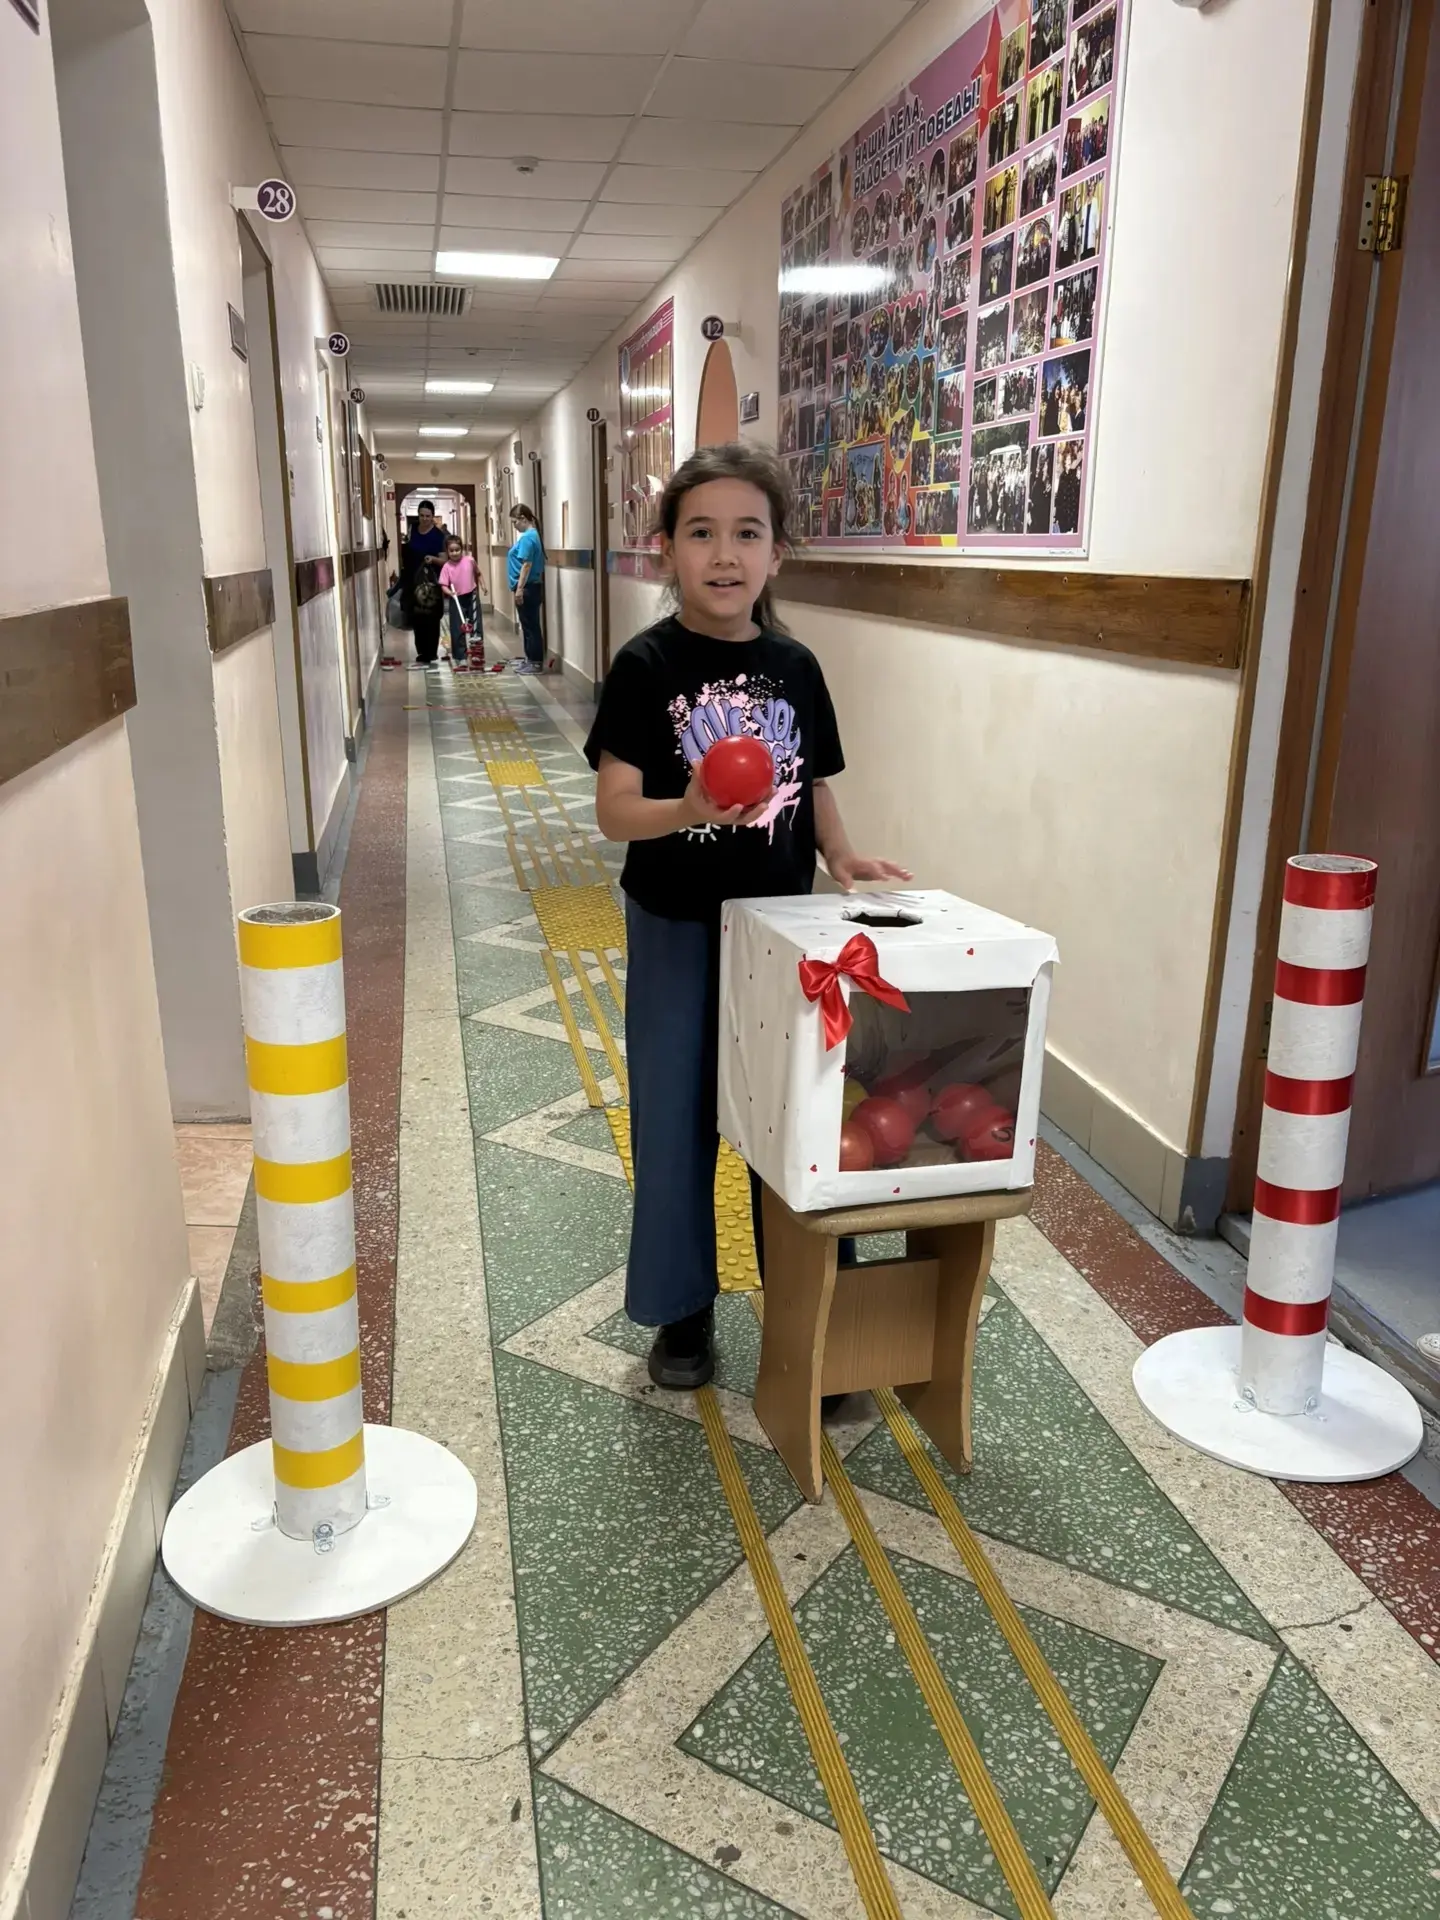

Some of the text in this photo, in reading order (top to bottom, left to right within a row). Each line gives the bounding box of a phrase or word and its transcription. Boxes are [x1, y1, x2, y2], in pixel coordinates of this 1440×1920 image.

[853, 75, 981, 202] РАДОСТИ И ПОБЕДЫ!
[854, 95, 924, 174] НАШИ ДЕЛА,
[262, 186, 291, 214] 28
[705, 320, 723, 337] 12
[331, 337, 346, 351] 29
[351, 390, 364, 401] 30
